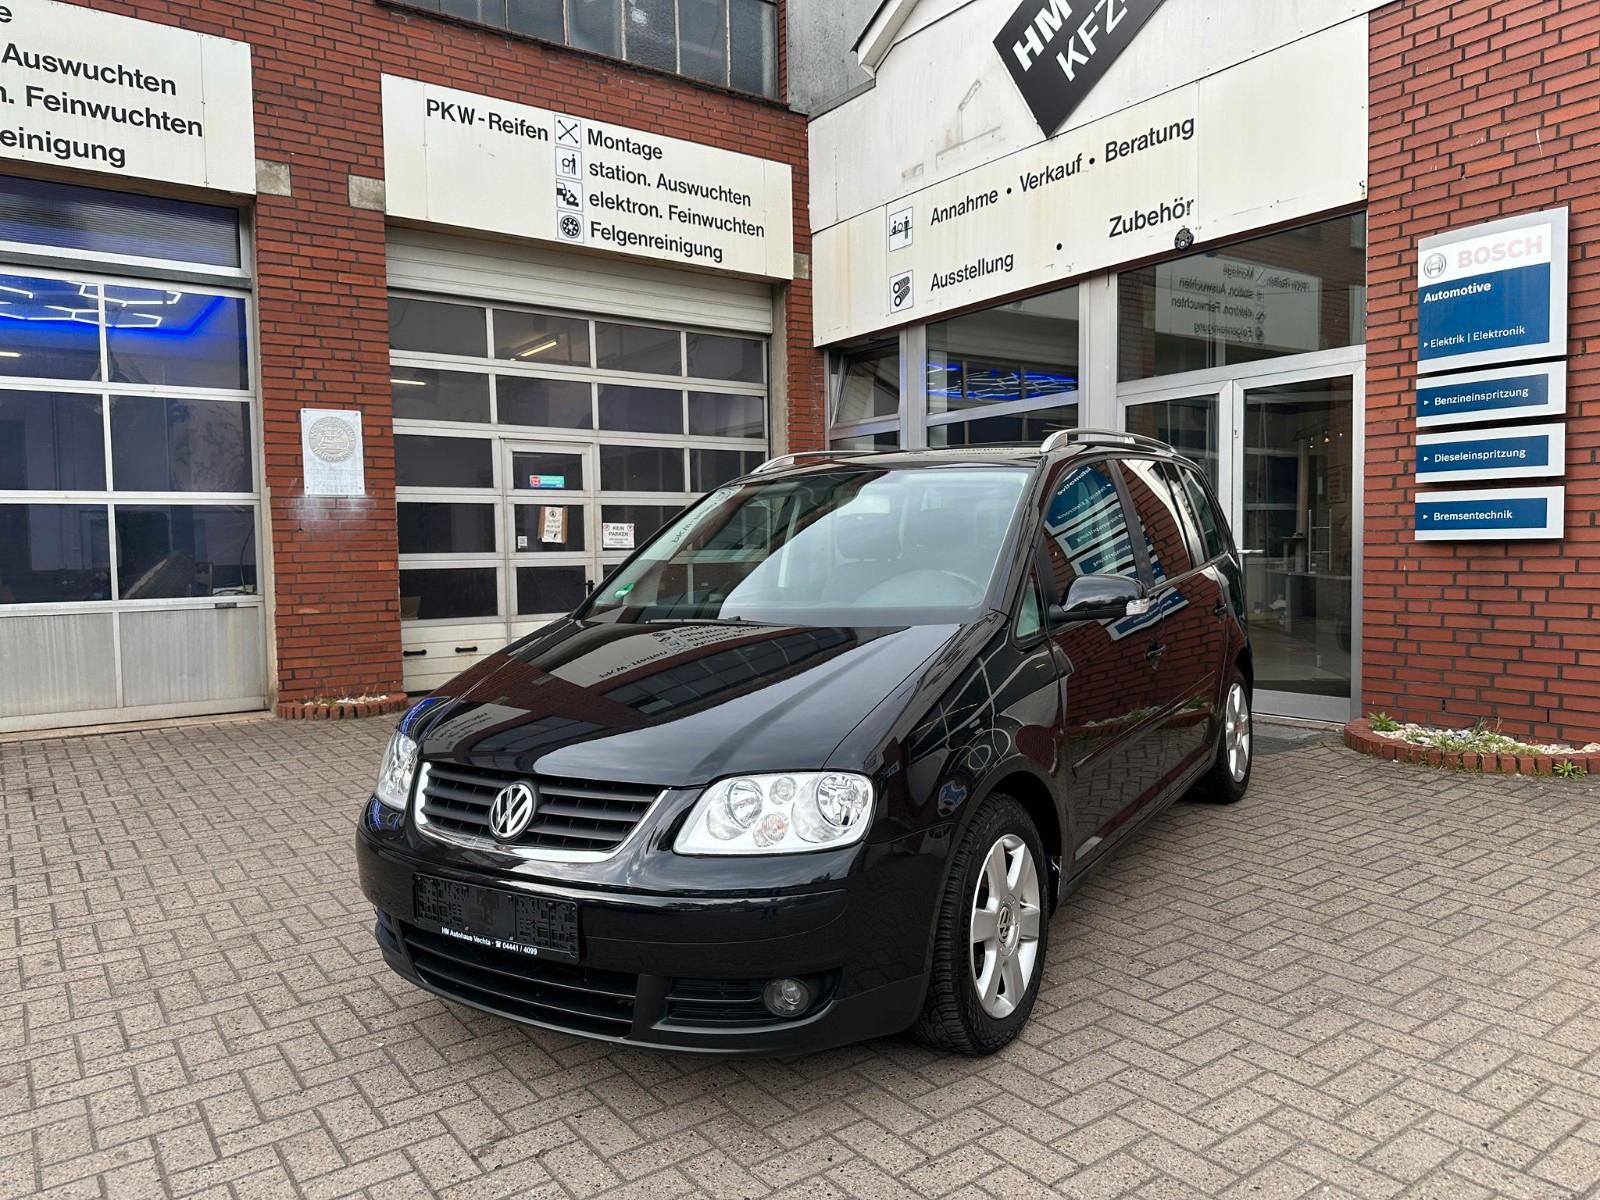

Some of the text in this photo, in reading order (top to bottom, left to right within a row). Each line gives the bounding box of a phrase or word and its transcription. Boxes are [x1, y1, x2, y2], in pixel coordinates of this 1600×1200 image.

[2, 42, 177, 96] Auswuchten
[25, 85, 203, 137] Feinwuchten
[426, 95, 549, 142] PKW-Reifen
[587, 128, 663, 161] Montage
[589, 161, 752, 207] station. Auswuchten
[930, 117, 1195, 226] Annahme Verkauf Beratung
[589, 191, 765, 238] elektron. Feinwuchten
[1109, 196, 1195, 238] Zubehör
[590, 221, 723, 264] Felgenreinigung
[1458, 235, 1543, 269] BOSCH
[930, 252, 1015, 292] Ausstellung
[1423, 282, 1492, 304] Automotive
[1430, 334, 1465, 348] Elektrik
[1473, 325, 1526, 341] Elektronik
[1434, 387, 1529, 406] Benzineinspritzung
[1434, 448, 1526, 463] Dieseleinspritzung
[1433, 510, 1513, 521] Bremsentechnik
[450, 929, 473, 942] Autohaus
[473, 935, 491, 946] Vechta
